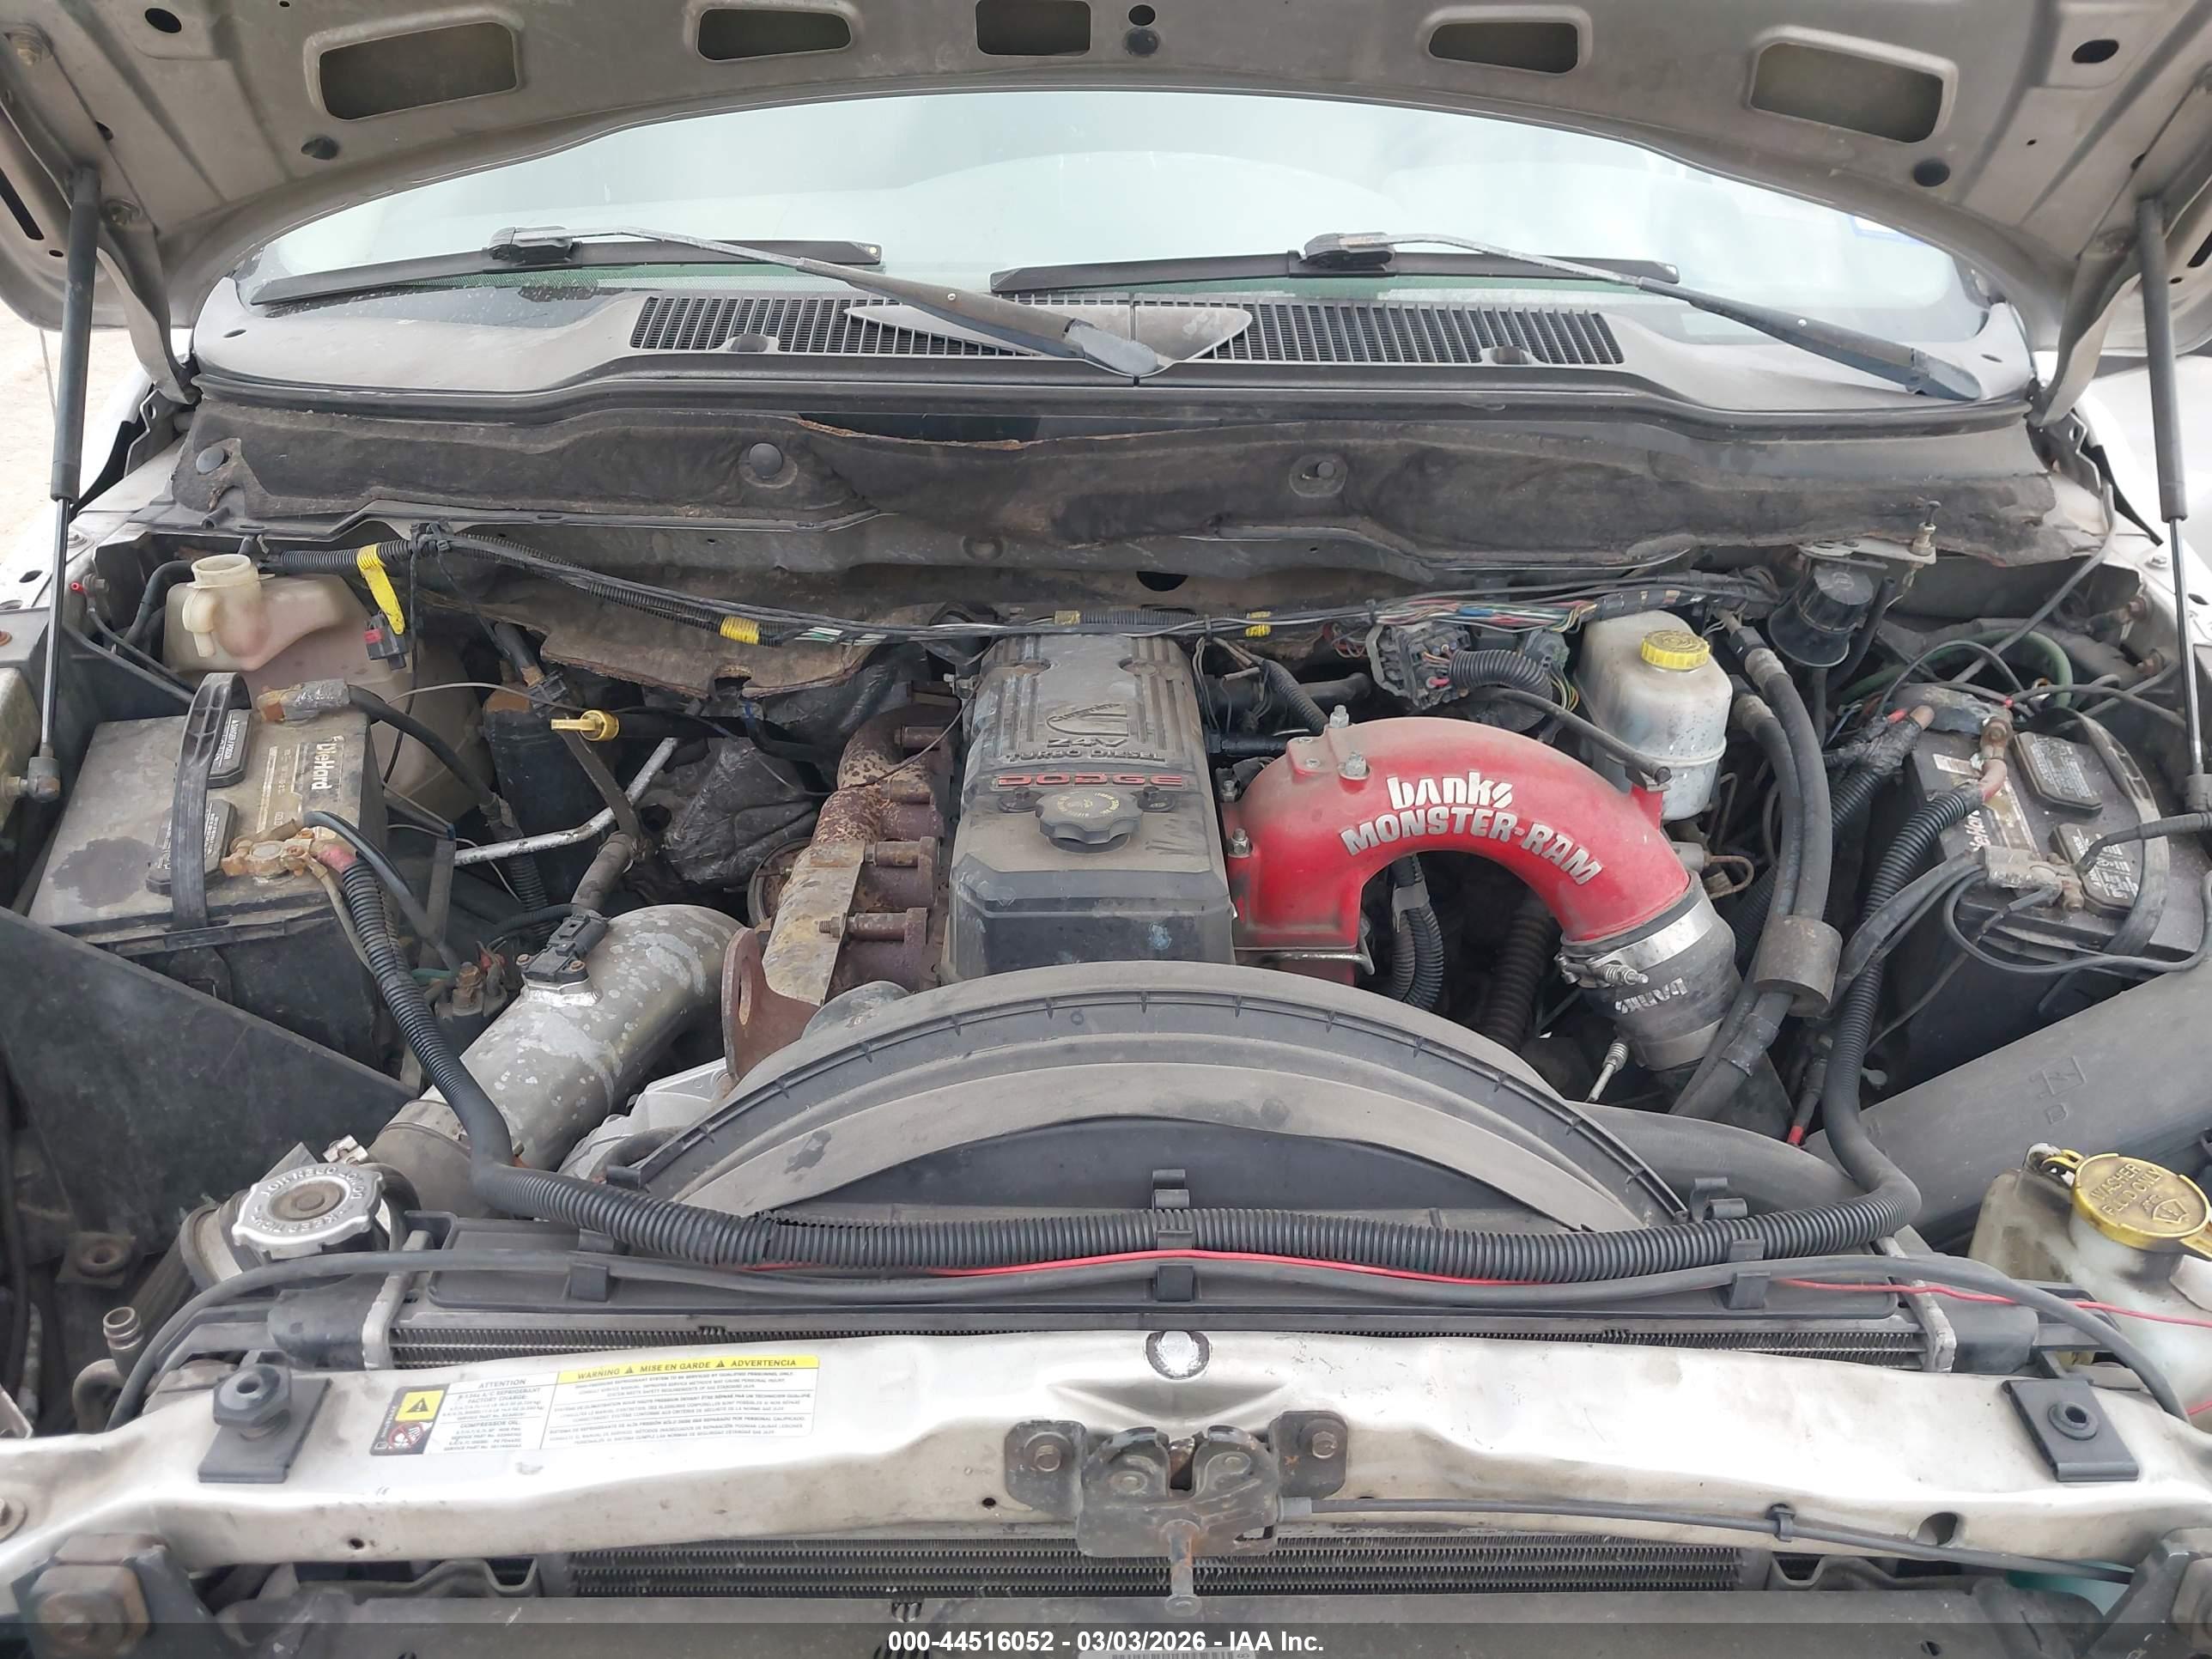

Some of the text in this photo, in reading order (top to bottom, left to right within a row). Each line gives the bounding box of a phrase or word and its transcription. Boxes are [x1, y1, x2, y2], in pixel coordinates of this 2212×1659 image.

[1047, 737, 1127, 749] 24V
[311, 743, 337, 790] DieHard
[1006, 749, 1166, 763] TURBO DIESEL
[997, 773, 1182, 787] DODGE
[1386, 770, 1514, 811] banks
[1340, 806, 1603, 885] MONSTER-RAM
[2090, 1164, 2142, 1200] WASHER
[2130, 1166, 2164, 1194] ONLY
[288, 1212, 341, 1234] KEEP
[577, 1368, 621, 1380] WARNING
[640, 1364, 663, 1373] MISE
[679, 1361, 712, 1370] GARDE
[477, 1379, 527, 1389] ATTENTION
